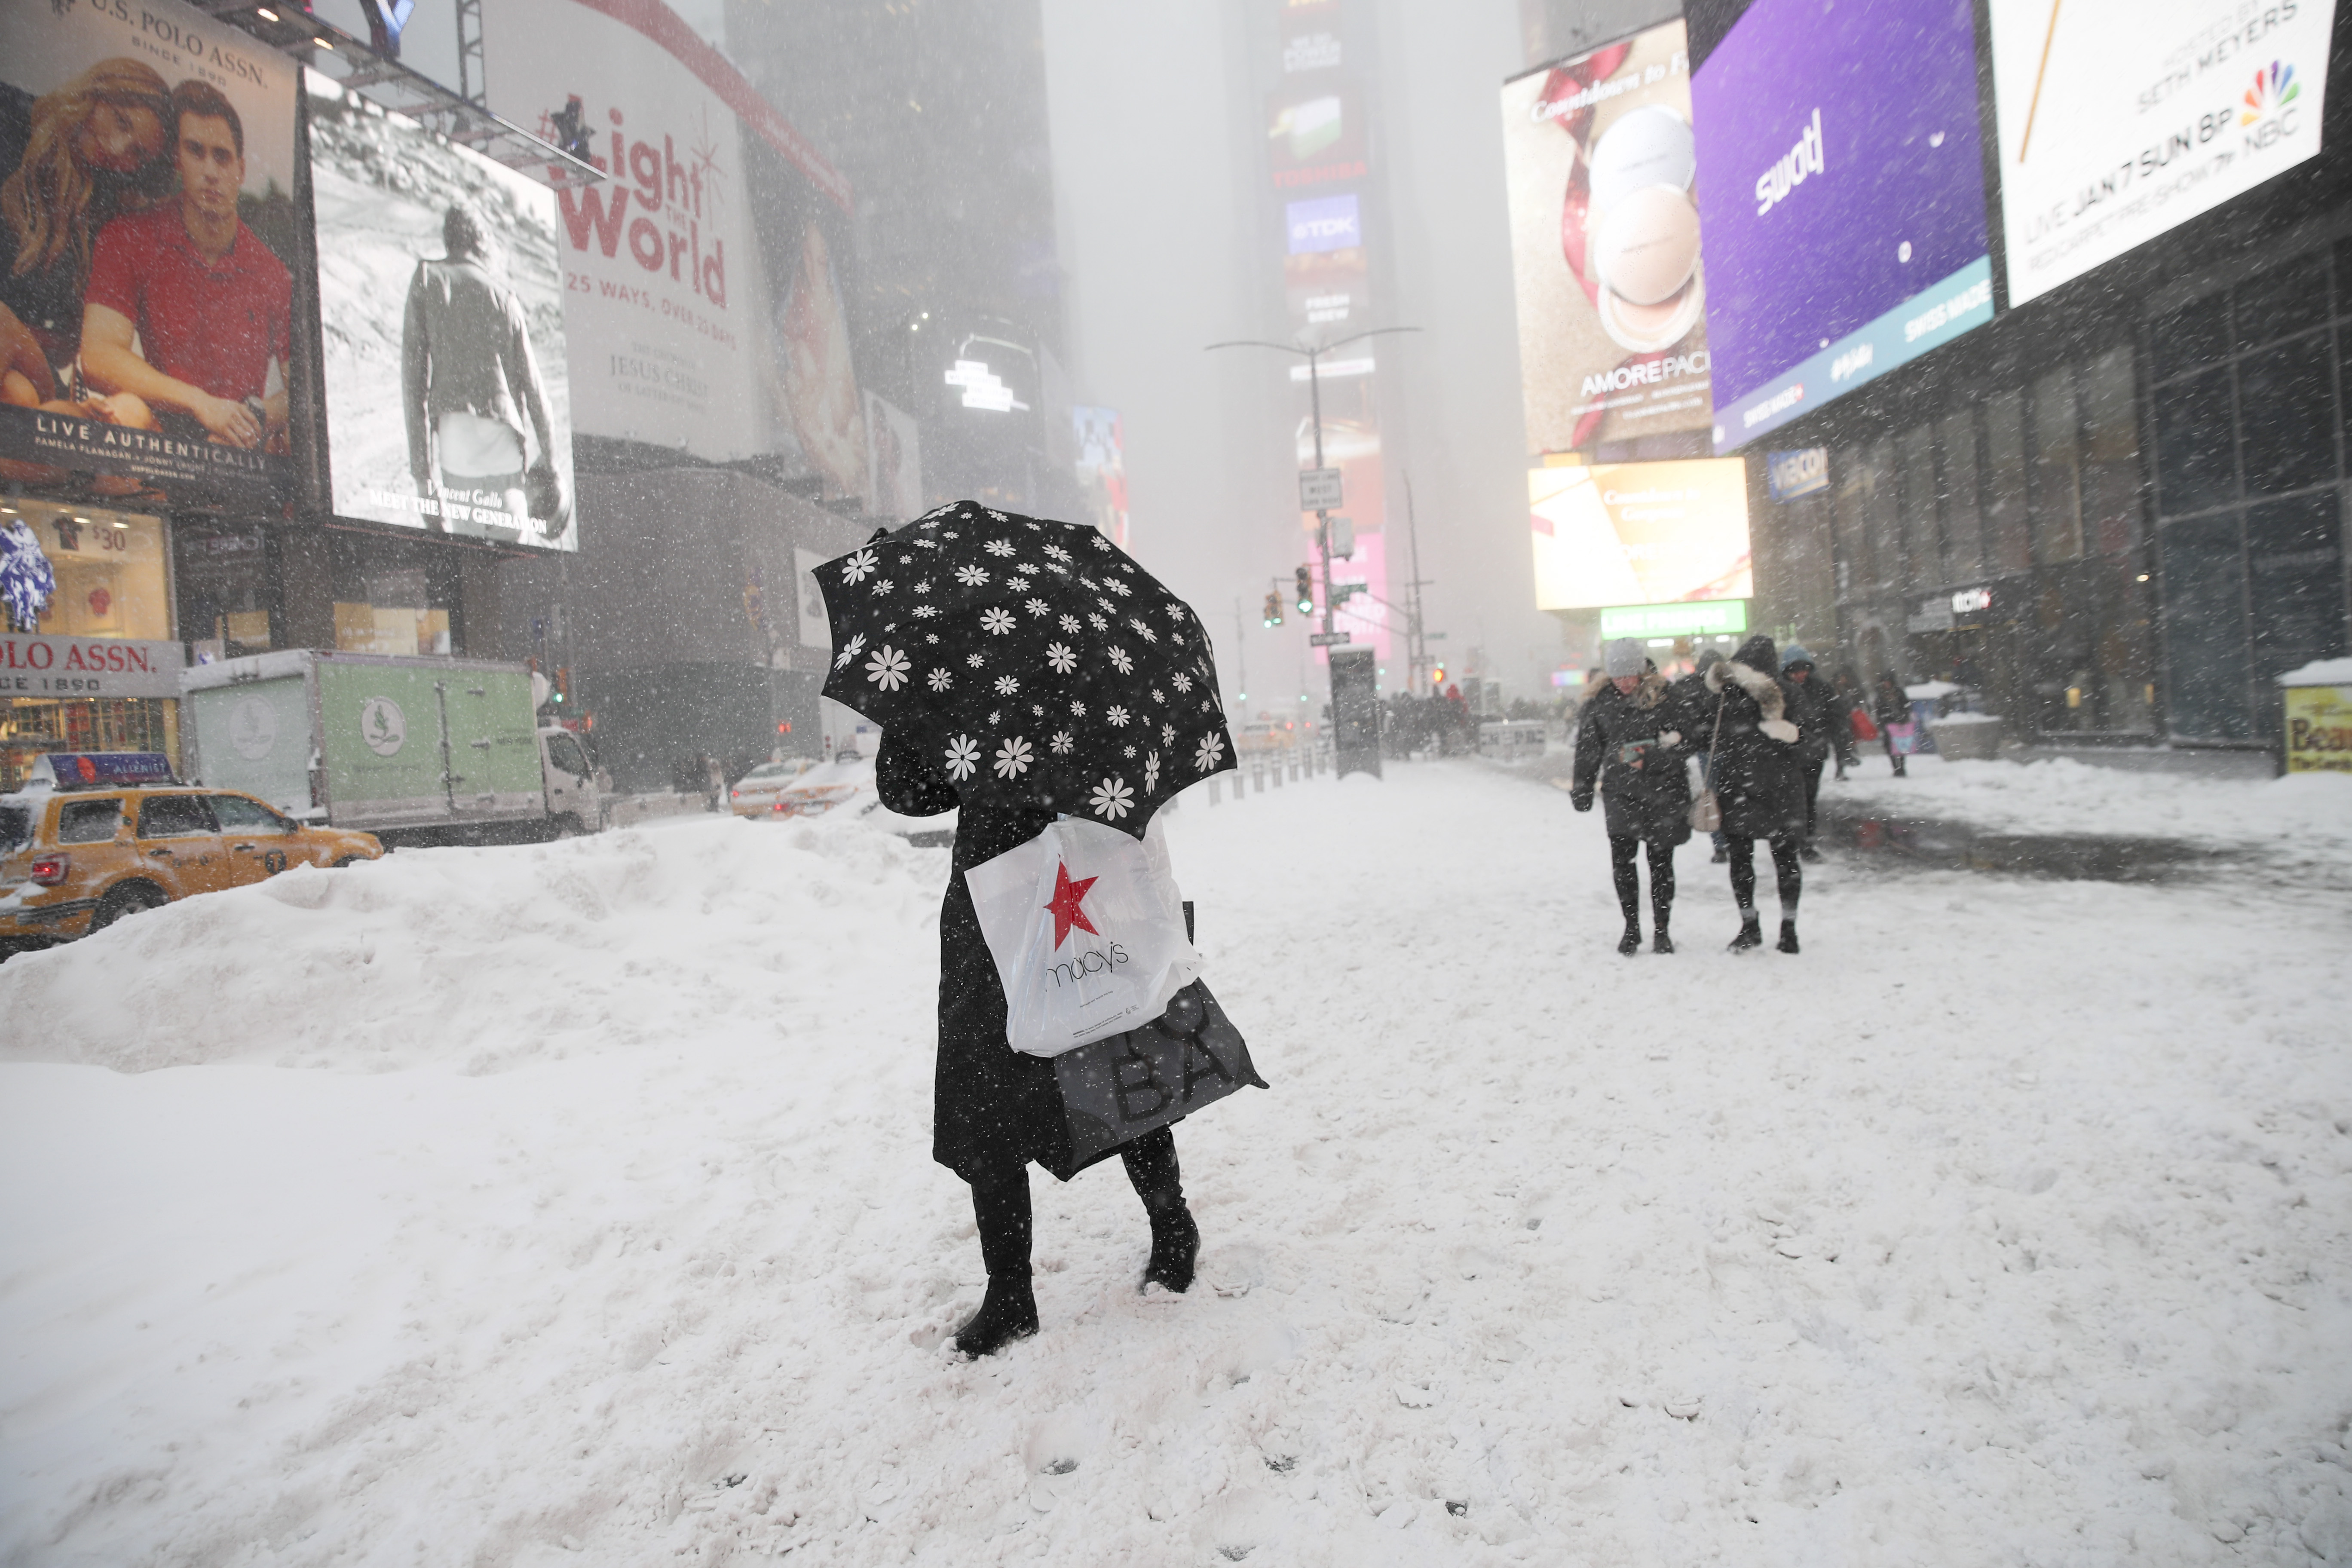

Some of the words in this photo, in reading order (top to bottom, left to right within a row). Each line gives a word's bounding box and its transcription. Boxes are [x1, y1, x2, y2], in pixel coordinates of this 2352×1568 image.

[132, 35, 181, 65] SINCE
[142, 10, 203, 56] POLO
[209, 46, 267, 89] ASSN.
[2138, 61, 2191, 113] SETH
[2197, 0, 2299, 77] MEYERS
[1530, 73, 1640, 123] Countdown
[1644, 64, 1666, 85] to
[2242, 109, 2299, 159] NBC
[1273, 160, 1367, 188] TOSHIBA
[2073, 172, 2117, 217] JAN
[2119, 160, 2133, 188] 7
[2138, 126, 2192, 178] SUN
[1307, 215, 1354, 237] TDK
[567, 273, 591, 293] 25
[610, 355, 661, 384] JESUS
[34, 436, 76, 452] PAMELA
[79, 444, 132, 461] FLANAGAN
[36, 416, 89, 440] LIVE
[104, 431, 266, 471] AUTHENTICALLY
[427, 478, 471, 503] Vincent
[472, 488, 503, 509] Gallo
[369, 489, 410, 508] MEET
[407, 496, 439, 516] THE
[440, 502, 472, 521] NEW
[472, 507, 548, 534] GENERATION
[93, 525, 126, 552] $30
[0, 640, 54, 670] LO
[65, 643, 157, 673] ASSN.
[43, 677, 100, 691] 1890
